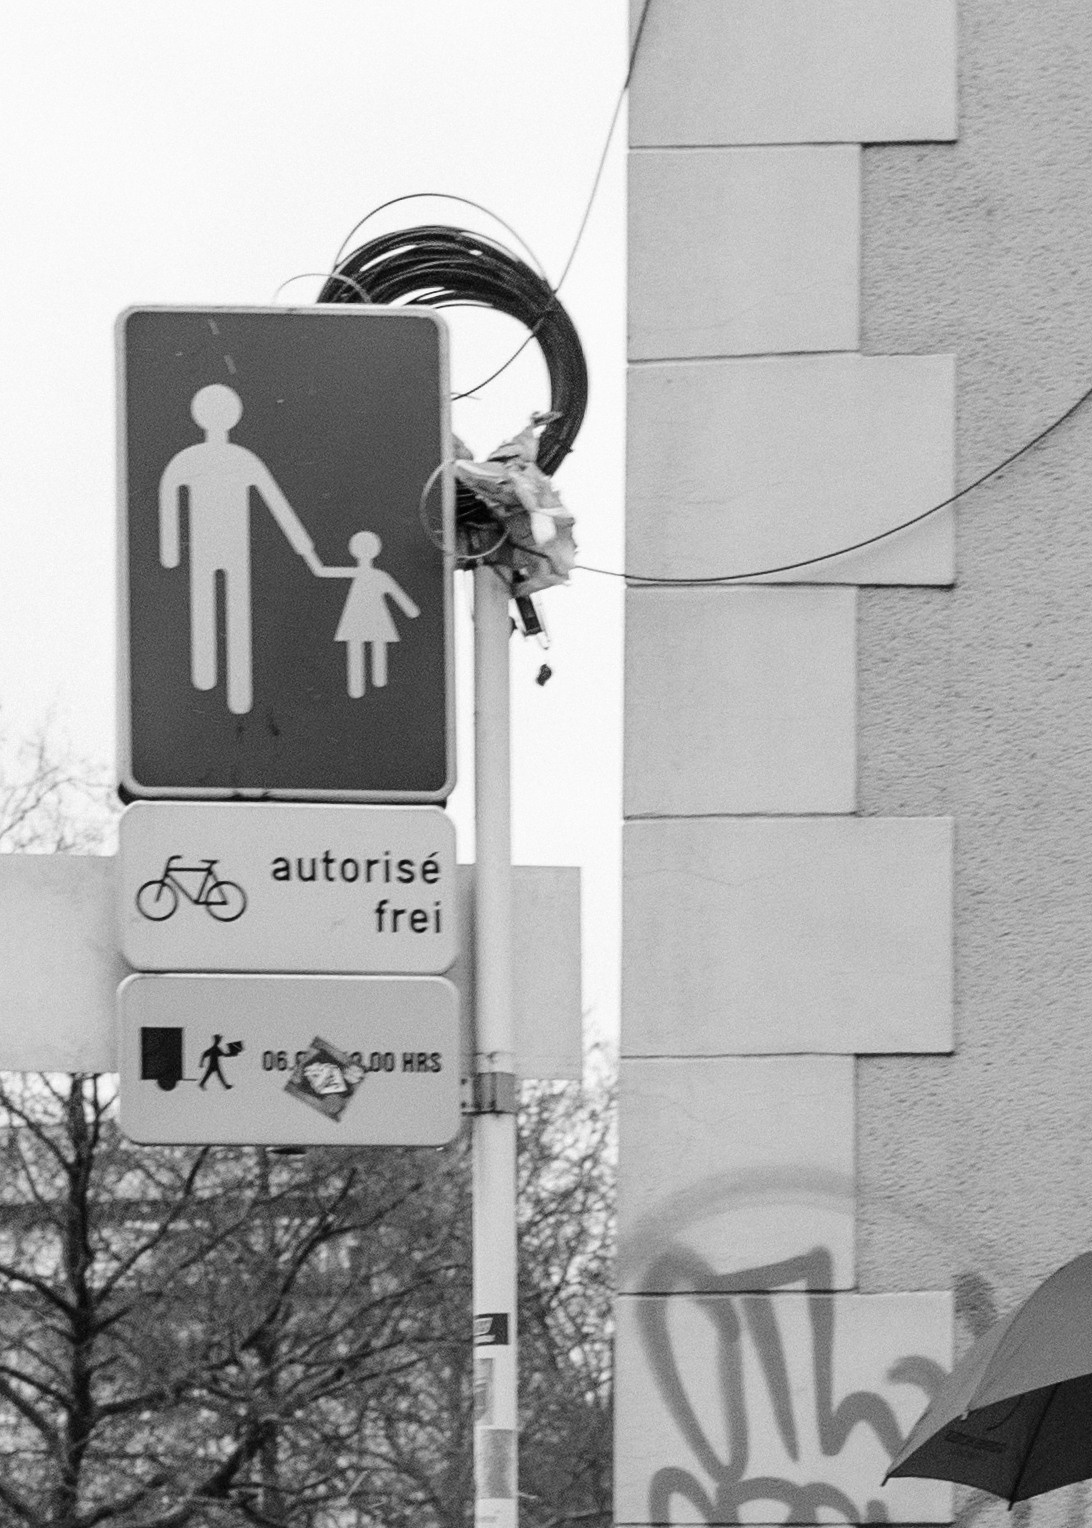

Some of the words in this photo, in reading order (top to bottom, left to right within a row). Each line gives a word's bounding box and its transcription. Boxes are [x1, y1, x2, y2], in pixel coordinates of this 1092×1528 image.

[270, 850, 441, 885] autorisé
[373, 899, 442, 934] frei
[401, 1051, 443, 1074] HRS
